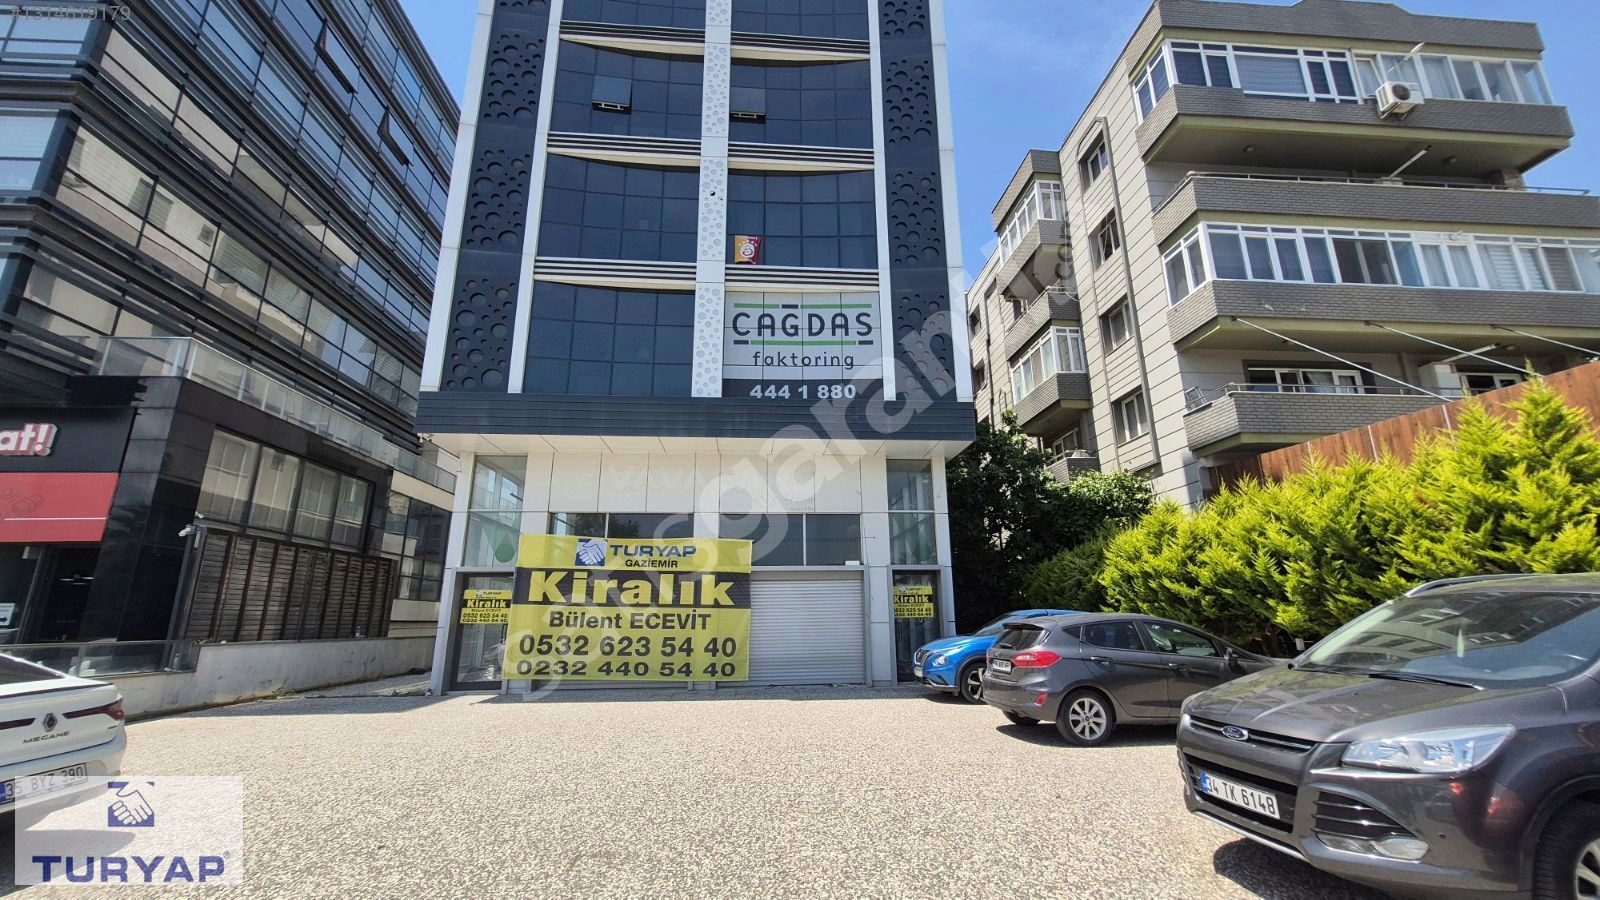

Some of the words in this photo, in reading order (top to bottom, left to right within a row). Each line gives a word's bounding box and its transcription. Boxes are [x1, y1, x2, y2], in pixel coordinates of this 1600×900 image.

[752, 351, 854, 370] faktoring
[750, 384, 791, 399] 444
[798, 385, 808, 399] 1
[817, 384, 856, 399] 880
[610, 544, 697, 558] TURYAP
[528, 571, 735, 605] Kiralık
[466, 599, 507, 608] Kiralık
[550, 610, 622, 629] Bülent
[630, 608, 711, 629] ECEVİT
[519, 634, 589, 656] 0532
[600, 636, 650, 657] 623
[661, 637, 694, 657] 54
[704, 637, 737, 658] 40
[517, 660, 587, 676] 0232
[597, 661, 649, 676] 440
[659, 662, 693, 677] 54
[702, 662, 736, 677] 40
[6, 781, 22, 797] 35
[31, 774, 55, 790] BYZ
[61, 766, 83, 782] 390
[1222, 782, 1237, 802] TK
[1241, 788, 1276, 815] 6148
